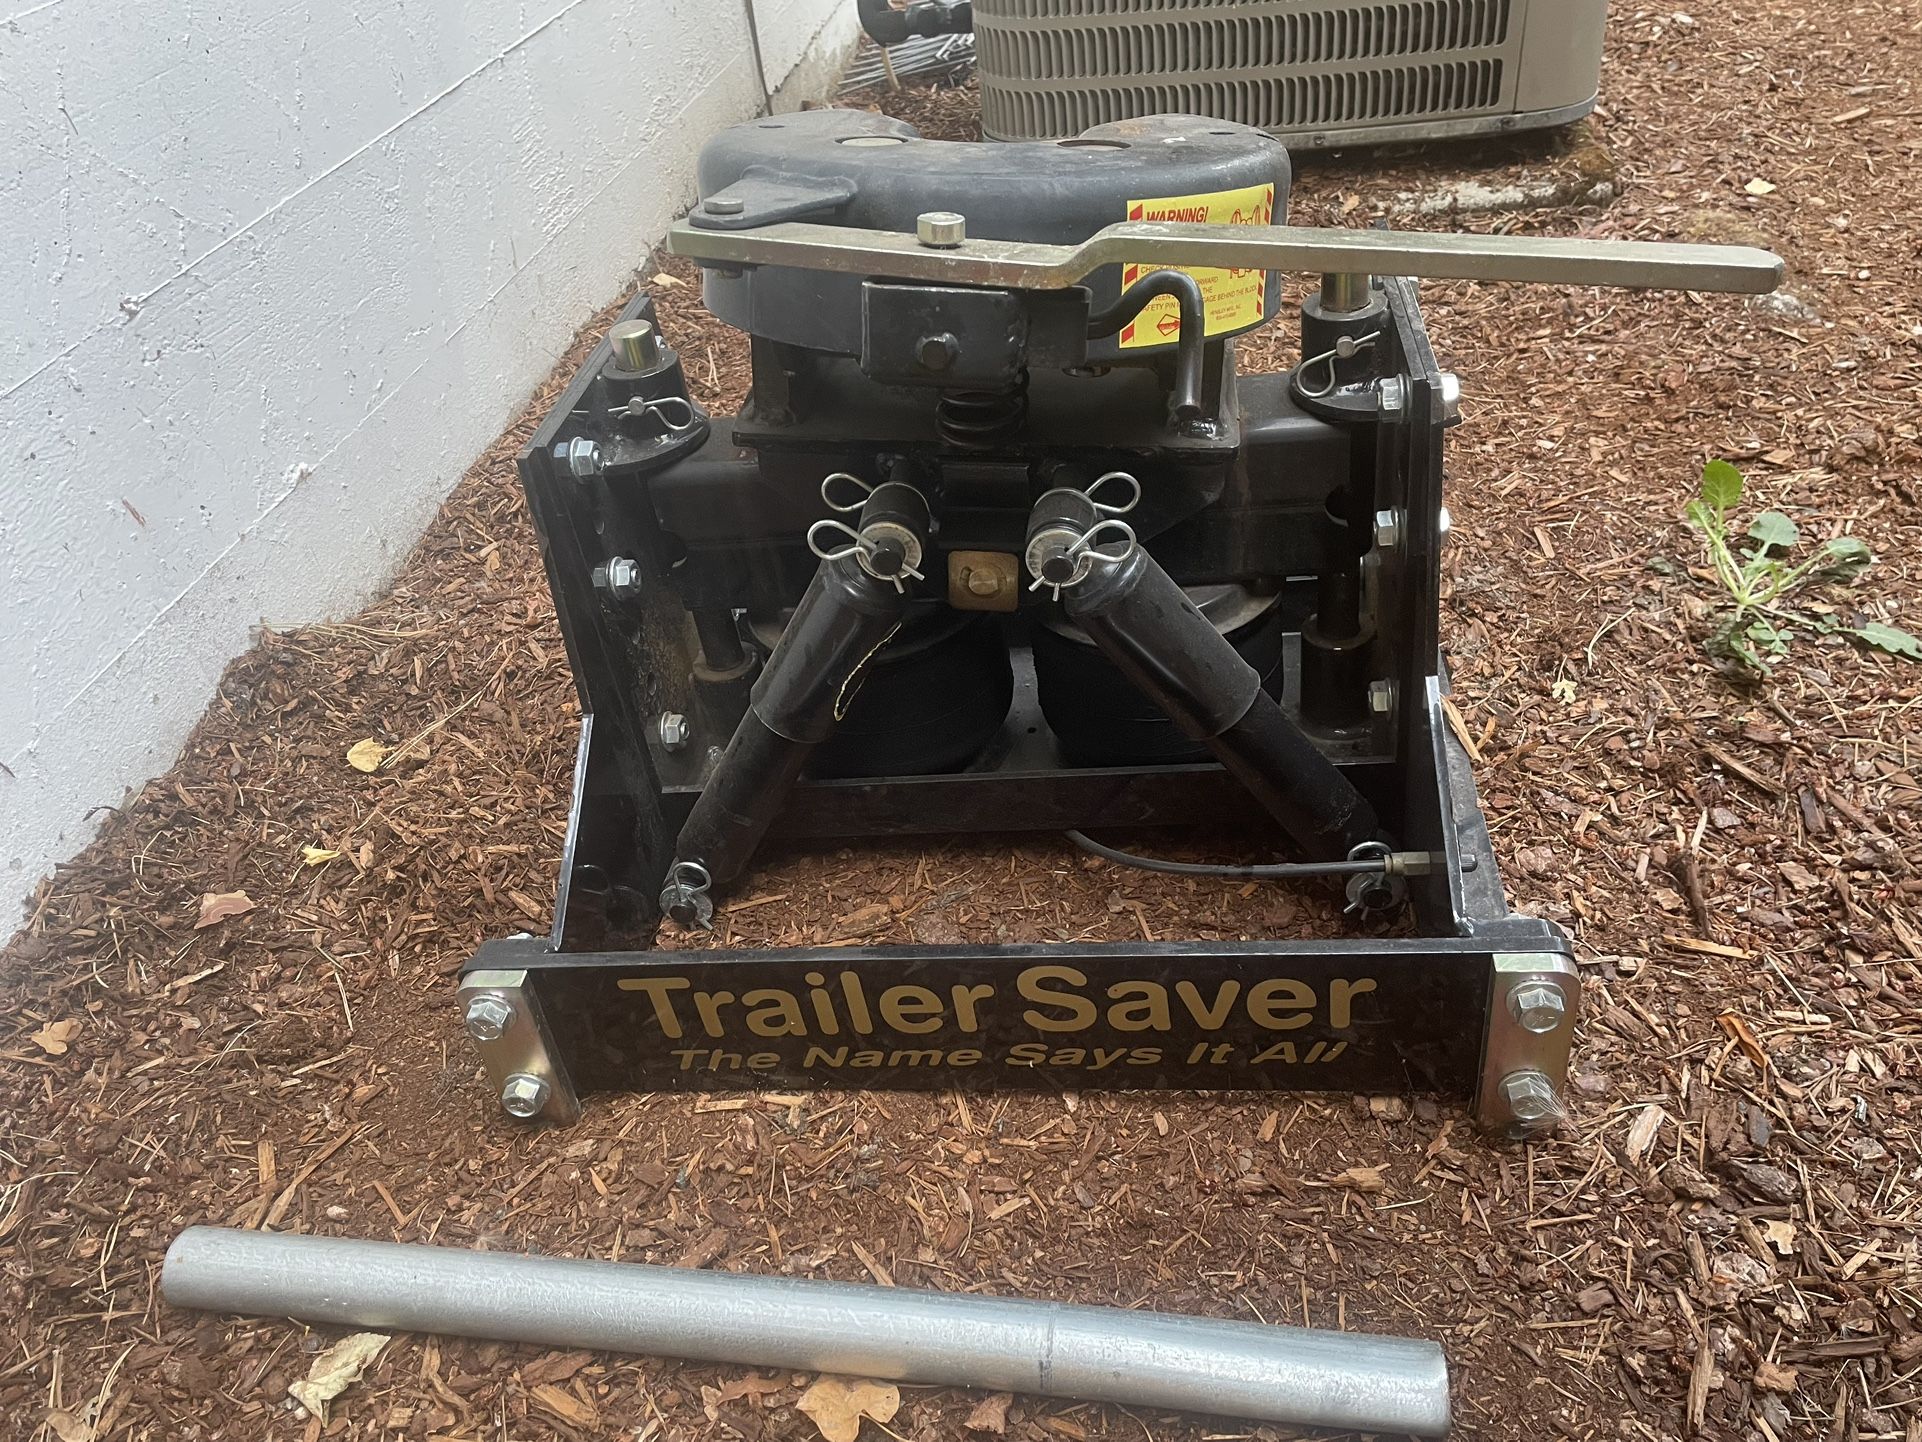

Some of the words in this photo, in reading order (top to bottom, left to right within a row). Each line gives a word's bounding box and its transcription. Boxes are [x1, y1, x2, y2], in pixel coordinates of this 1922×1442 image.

[1146, 206, 1209, 223] WARNING!
[616, 971, 995, 1039] Trailer
[1016, 965, 1378, 1033] Saver
[670, 1048, 782, 1071] The
[802, 1046, 983, 1069] Name
[1004, 1043, 1163, 1071] Says
[1186, 1041, 1235, 1065] It
[1249, 1041, 1348, 1065] All
